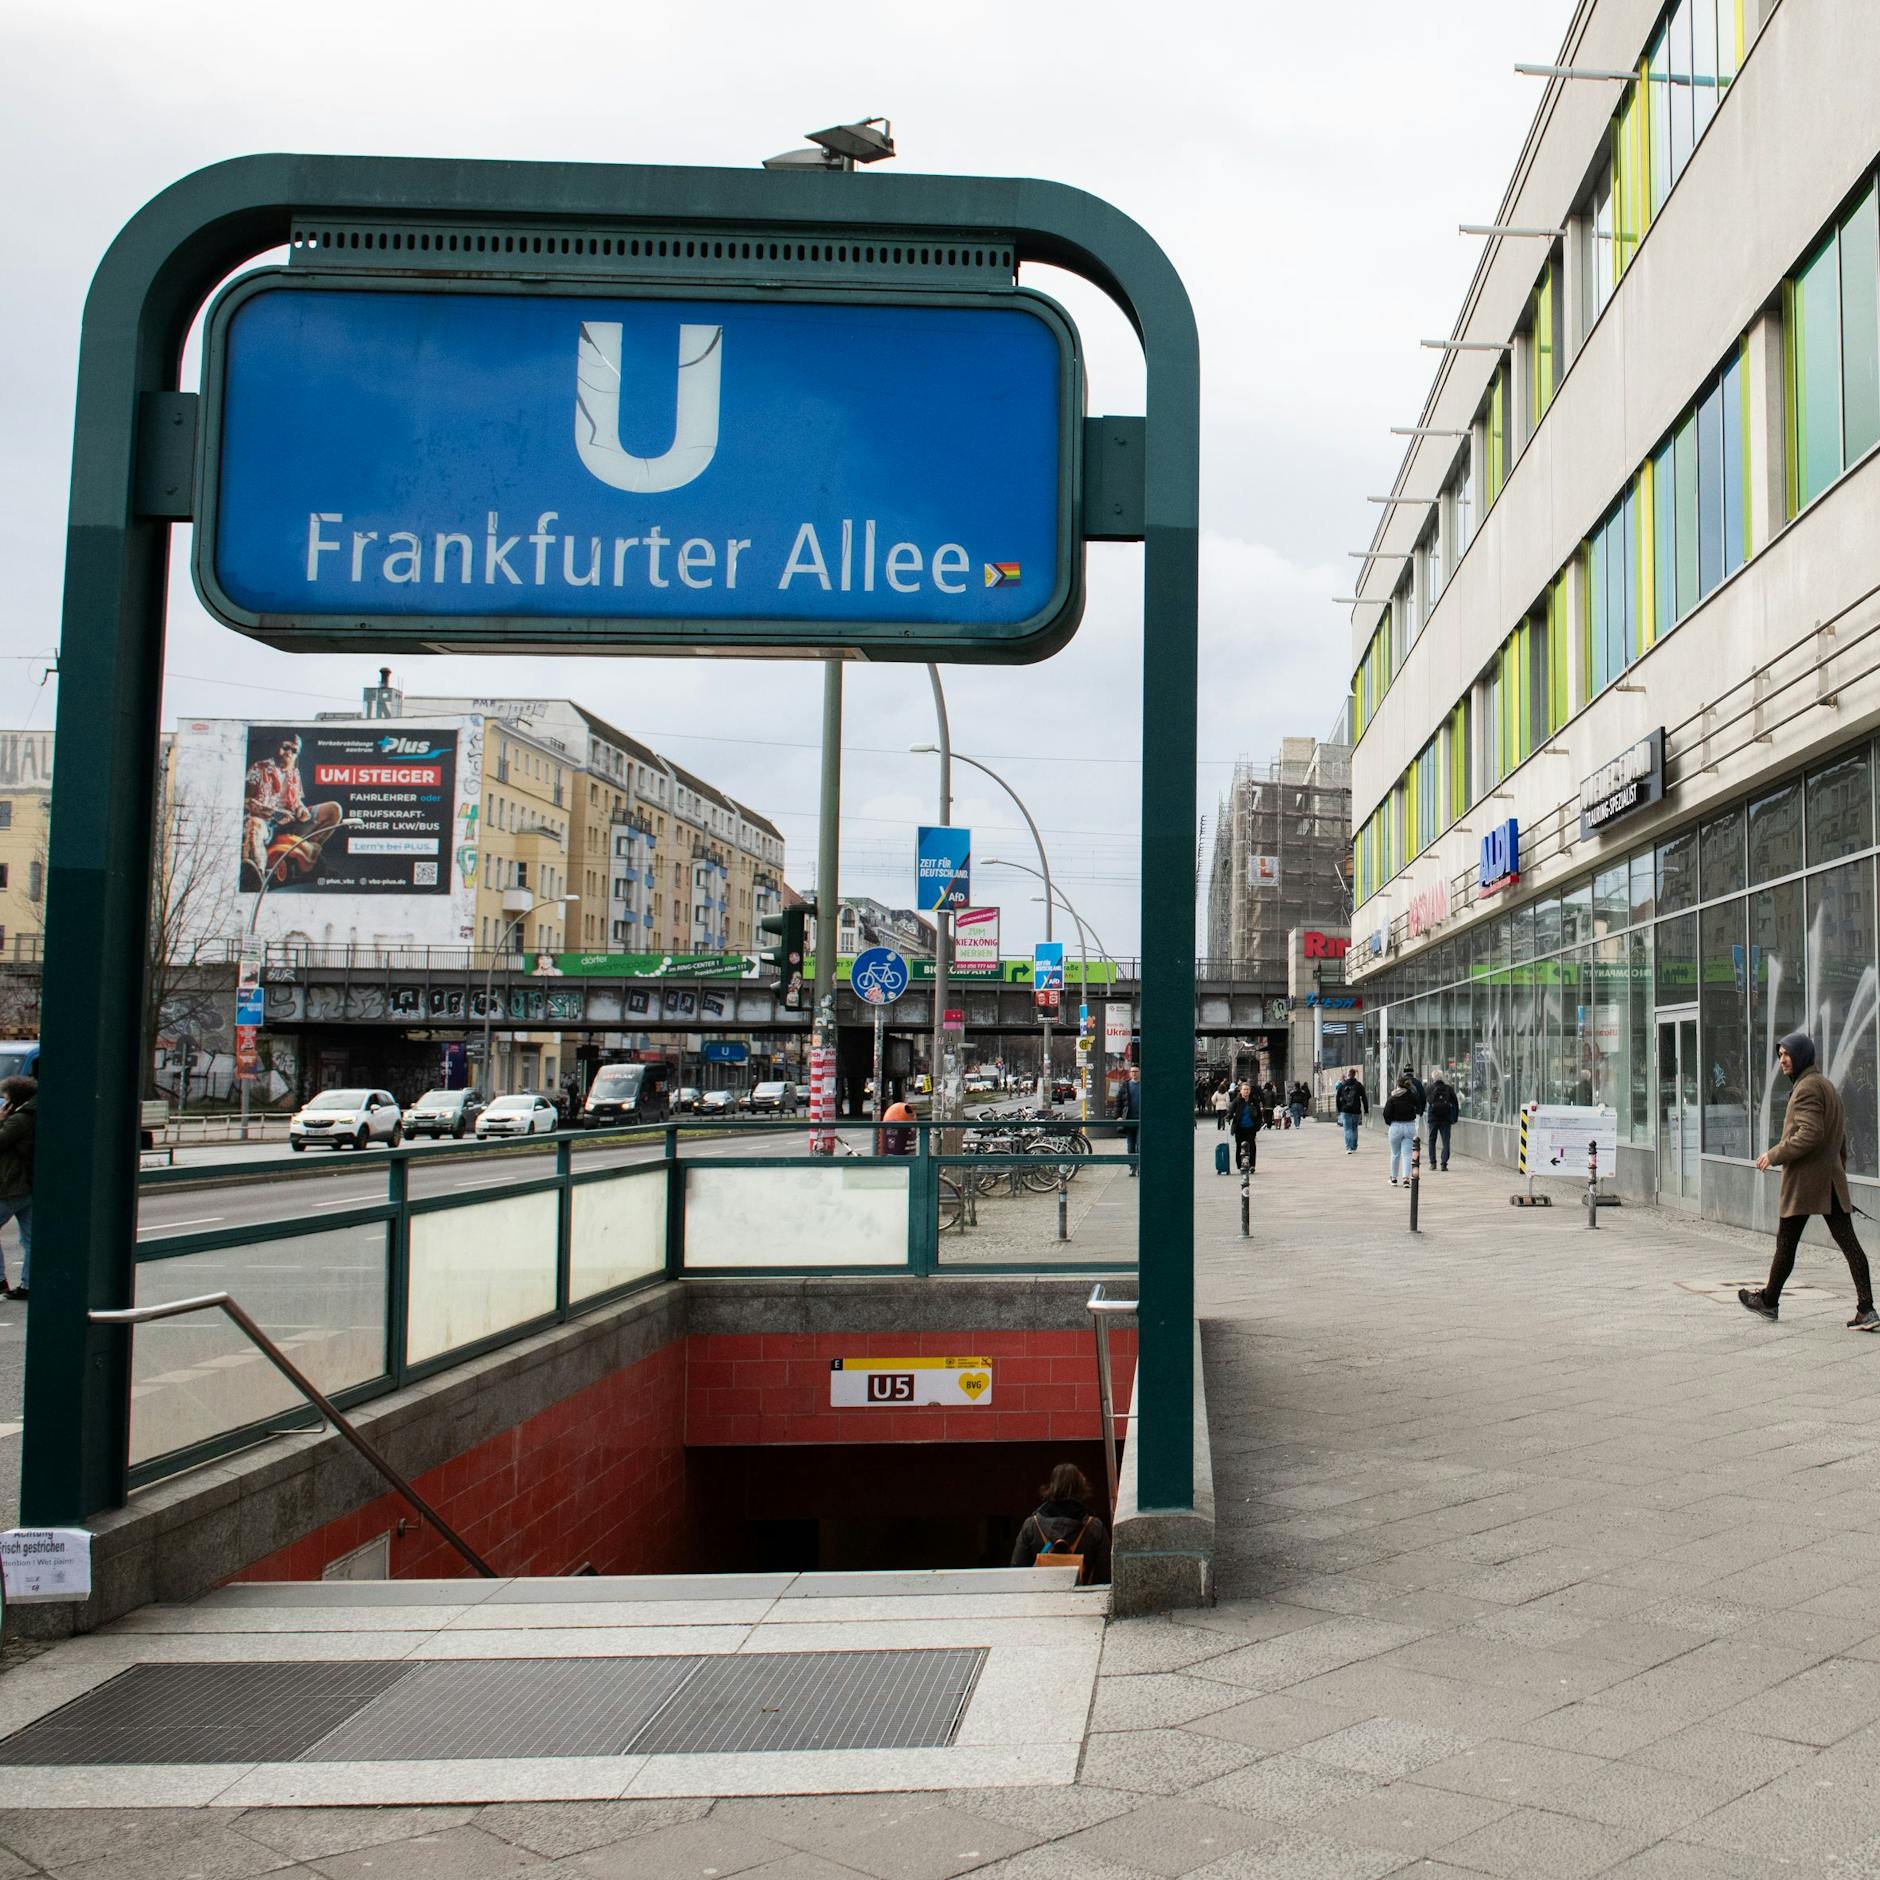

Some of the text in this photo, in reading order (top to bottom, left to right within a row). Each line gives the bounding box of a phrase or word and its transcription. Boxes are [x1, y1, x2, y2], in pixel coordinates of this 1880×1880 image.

[575, 321, 722, 493] U
[306, 511, 970, 593] Frankfurter Allee
[382, 737, 431, 754] Plus
[320, 768, 436, 784] UM STEIGER
[349, 793, 442, 802] FAHRLEHRER oder
[349, 810, 426, 819] BERUFSKRAFT-
[392, 822, 440, 831] LKW/BUS
[1479, 818, 1518, 884] ALDI
[920, 857, 952, 869] ZEIT FÜR
[948, 892, 965, 902] AfD
[968, 927, 986, 936] ZUM
[956, 937, 998, 947] KIEZKÖNIG
[721, 1047, 729, 1056] U
[834, 1359, 840, 1368] E
[873, 1376, 910, 1400] U5
[966, 1380, 982, 1390] BVG
[0, 1540, 65, 1557] risch gestrichen
